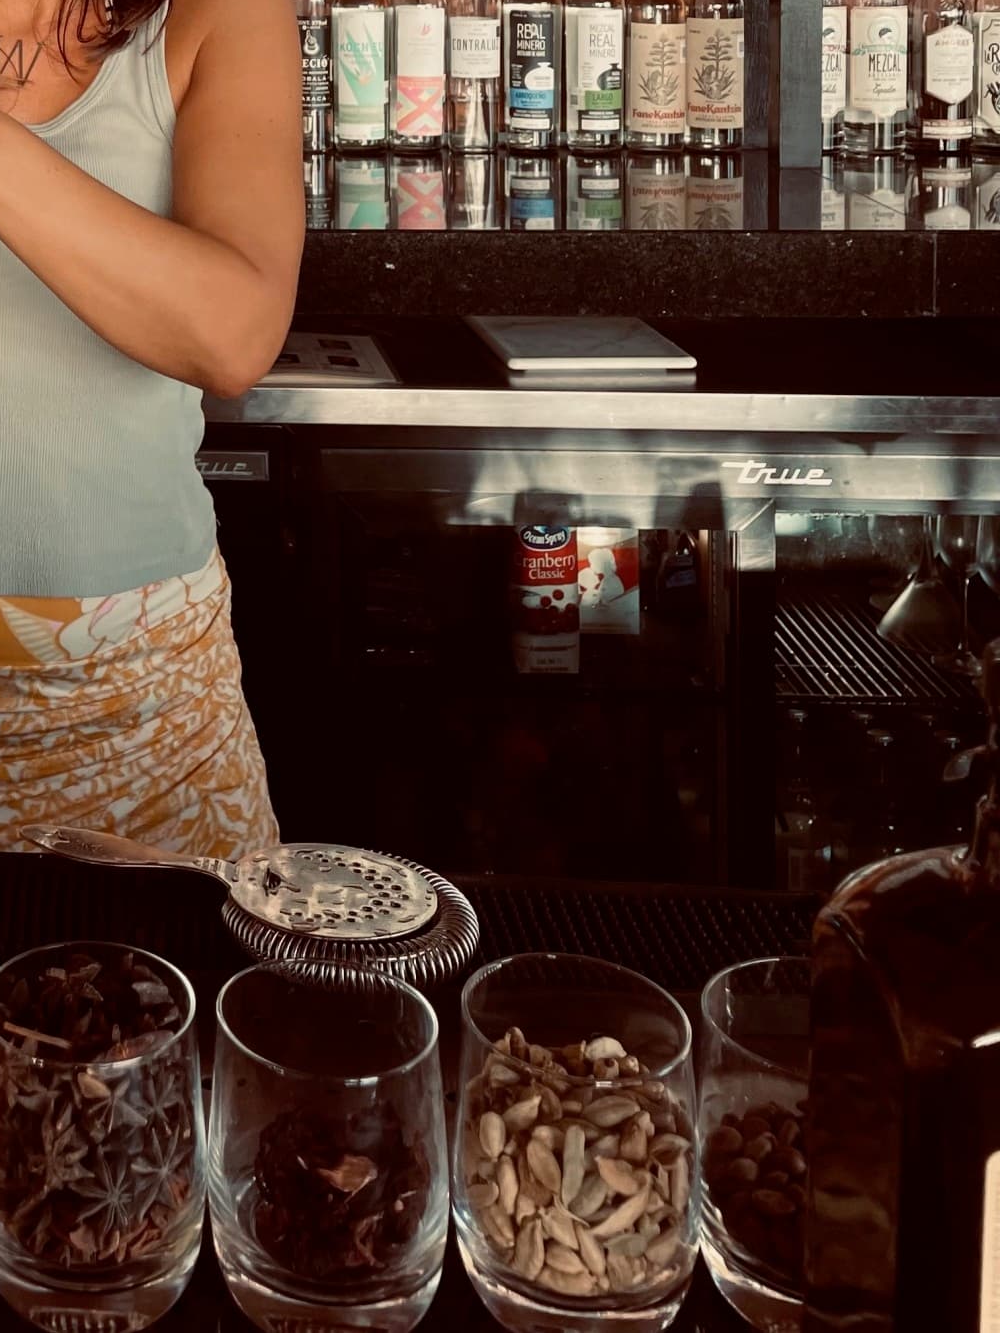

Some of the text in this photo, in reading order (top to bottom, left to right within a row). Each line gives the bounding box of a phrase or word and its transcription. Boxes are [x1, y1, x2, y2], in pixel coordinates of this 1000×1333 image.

[516, 23, 546, 40] REAL
[516, 40, 546, 51] MINERO
[589, 33, 616, 48] REAL
[302, 53, 329, 68] ECIÓ
[589, 48, 616, 59] MINERO
[822, 53, 842, 73] EZCAL
[868, 53, 902, 73] MEZCAL
[302, 95, 327, 103] AXACA
[195, 458, 254, 476] rue
[721, 460, 833, 486] true
[522, 552, 576, 571] ranberry
[528, 568, 566, 580] Classic
